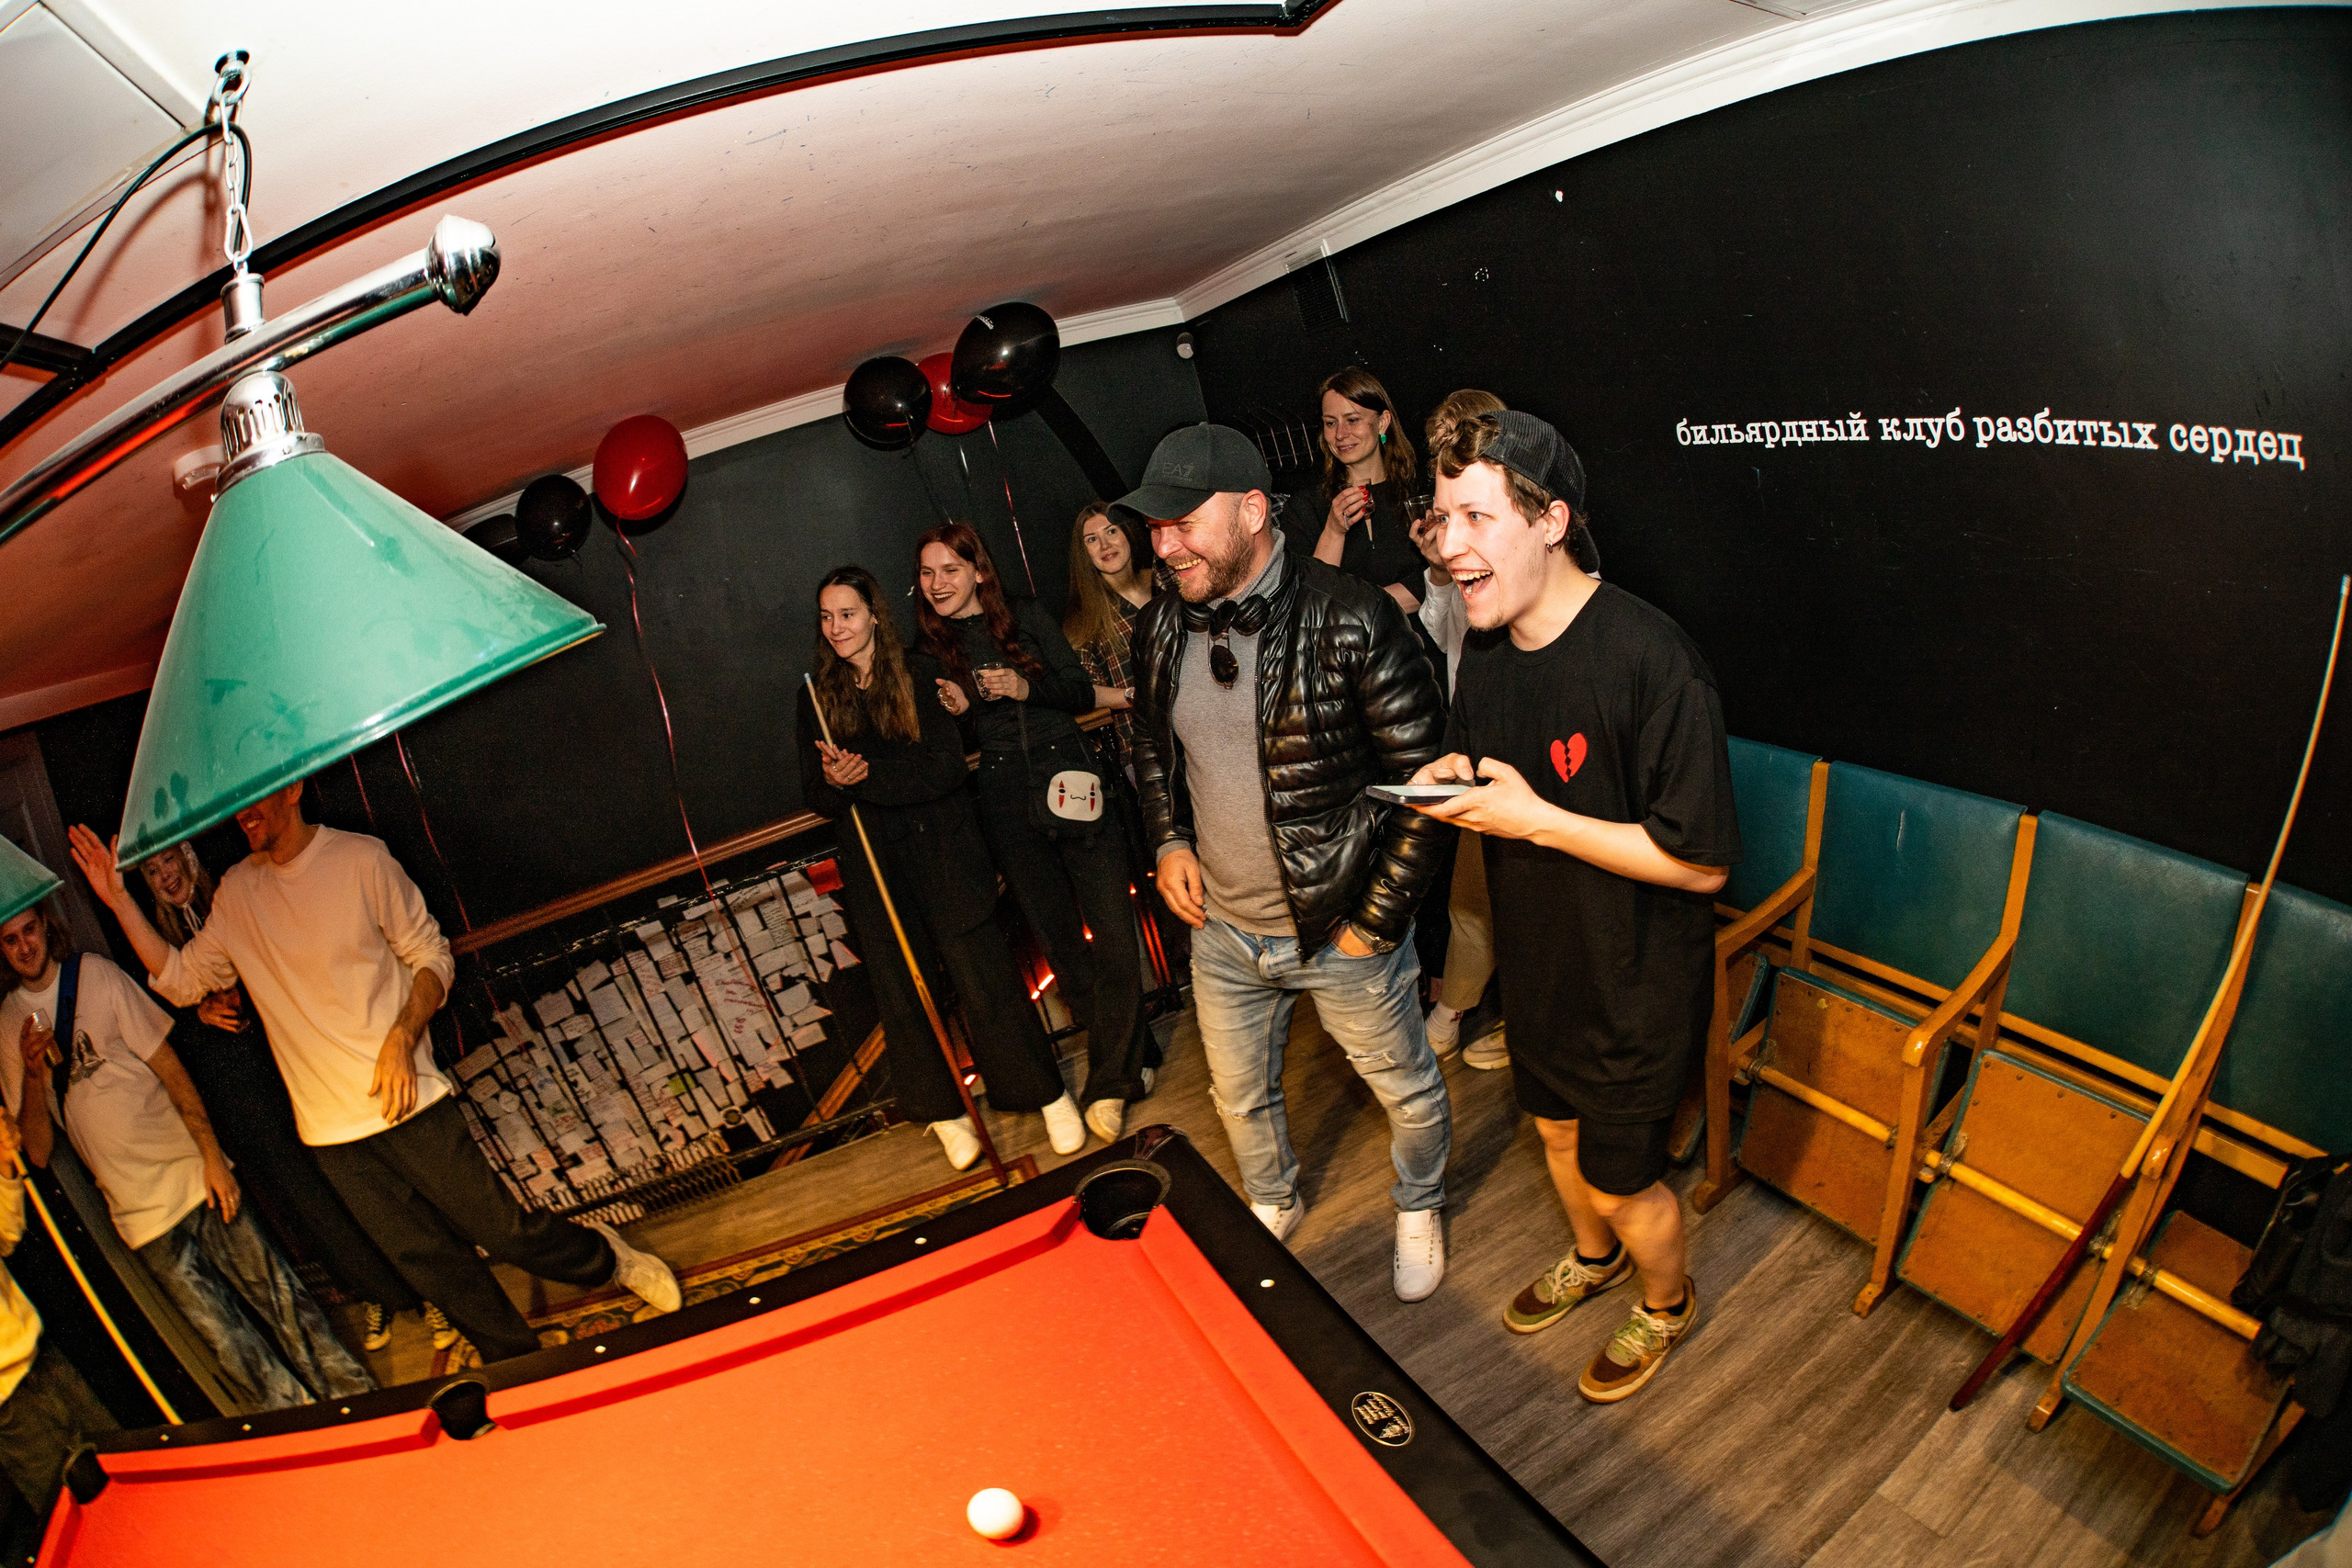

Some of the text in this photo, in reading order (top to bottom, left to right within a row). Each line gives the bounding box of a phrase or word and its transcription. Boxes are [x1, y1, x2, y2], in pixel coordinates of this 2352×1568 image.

[1677, 407, 2305, 470] бильярдный клуб разбитых сердец
